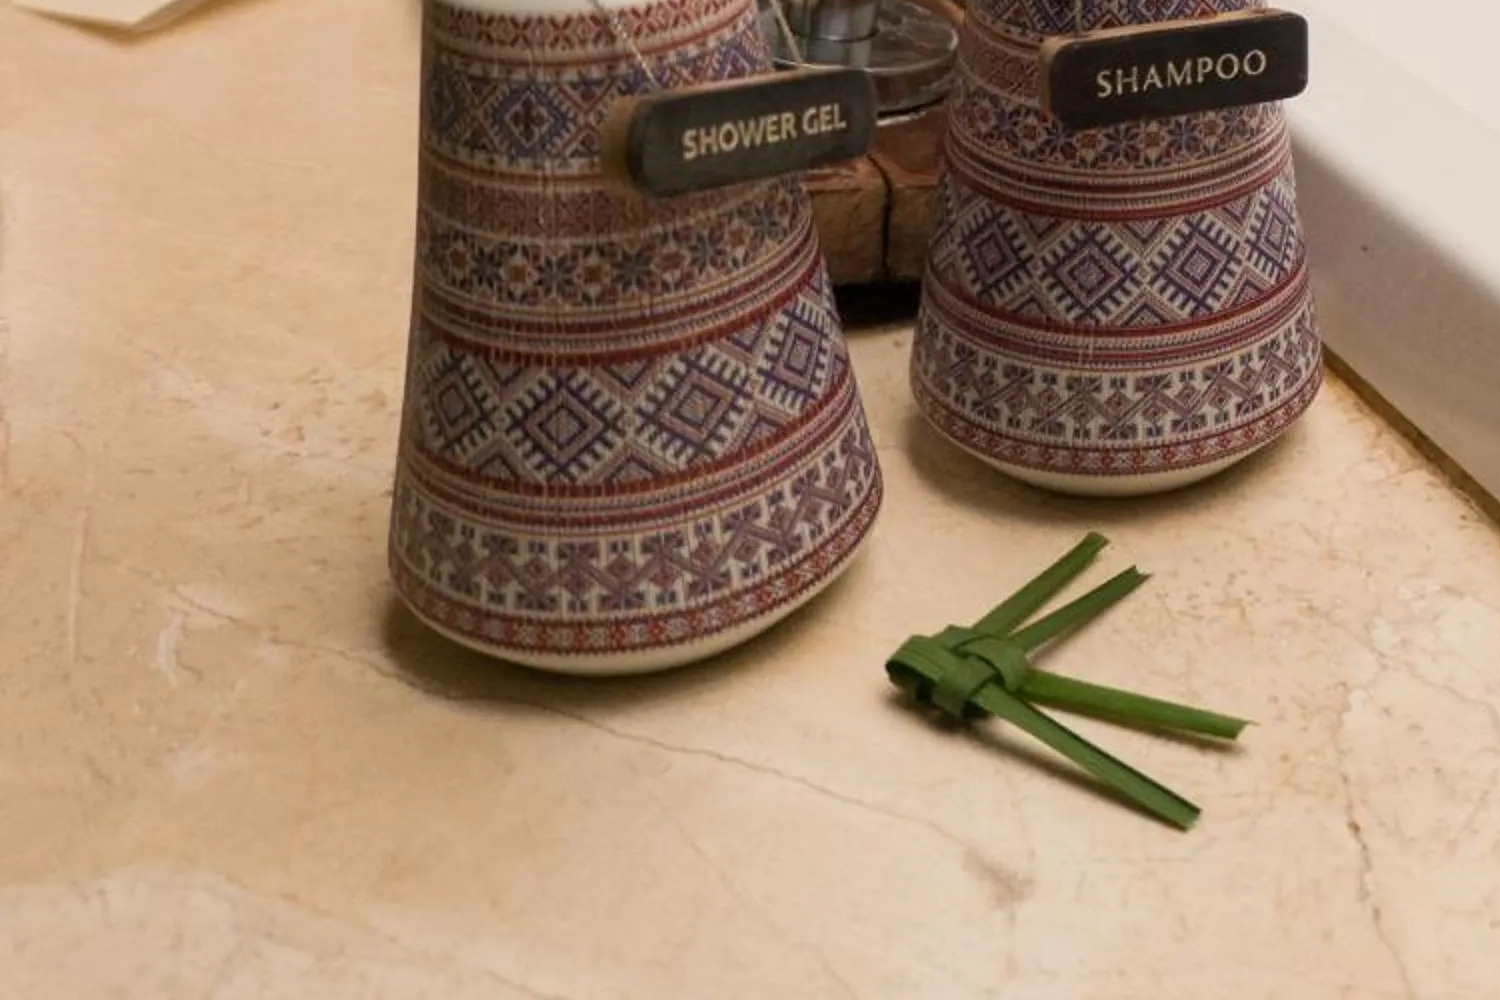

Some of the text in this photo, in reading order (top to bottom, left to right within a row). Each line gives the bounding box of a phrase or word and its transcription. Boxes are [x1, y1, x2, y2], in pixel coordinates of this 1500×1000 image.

[1096, 49, 1267, 98] SHAMPOO
[682, 103, 847, 160] SHOWER GEL
